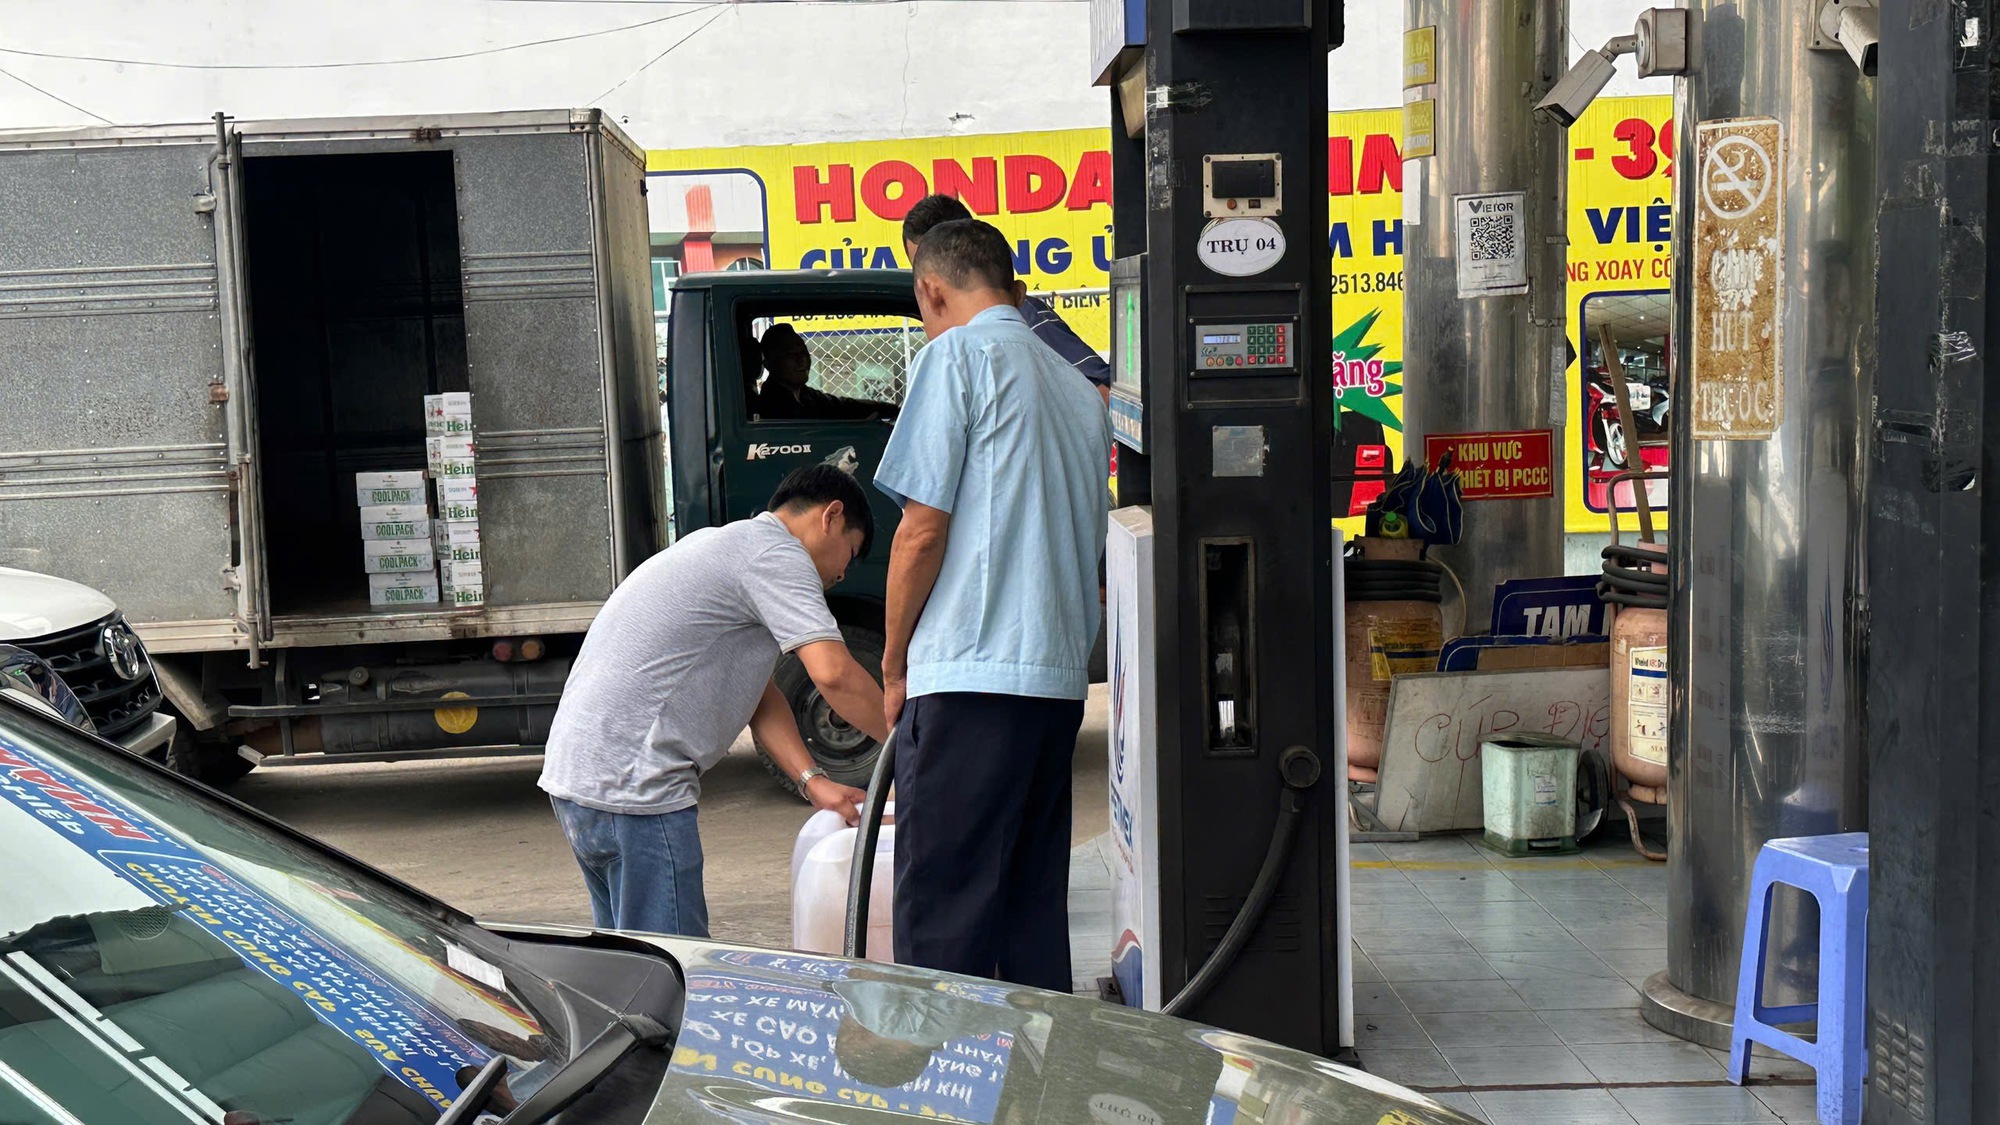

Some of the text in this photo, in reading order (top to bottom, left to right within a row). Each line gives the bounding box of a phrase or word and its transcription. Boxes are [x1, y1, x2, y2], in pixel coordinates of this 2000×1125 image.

[793, 150, 1112, 224] HONDA
[1206, 237, 1276, 255] TRỤ 04
[1595, 259, 1644, 281] XOAY
[1458, 439, 1523, 464] KHU VỰC
[1494, 469, 1510, 490] BỊ
[1513, 467, 1549, 487] PCCC
[372, 489, 411, 504] COOLPACK
[376, 523, 415, 537] COOLPACK
[379, 556, 418, 569] COOLPACK
[385, 588, 424, 601] COOLPACK
